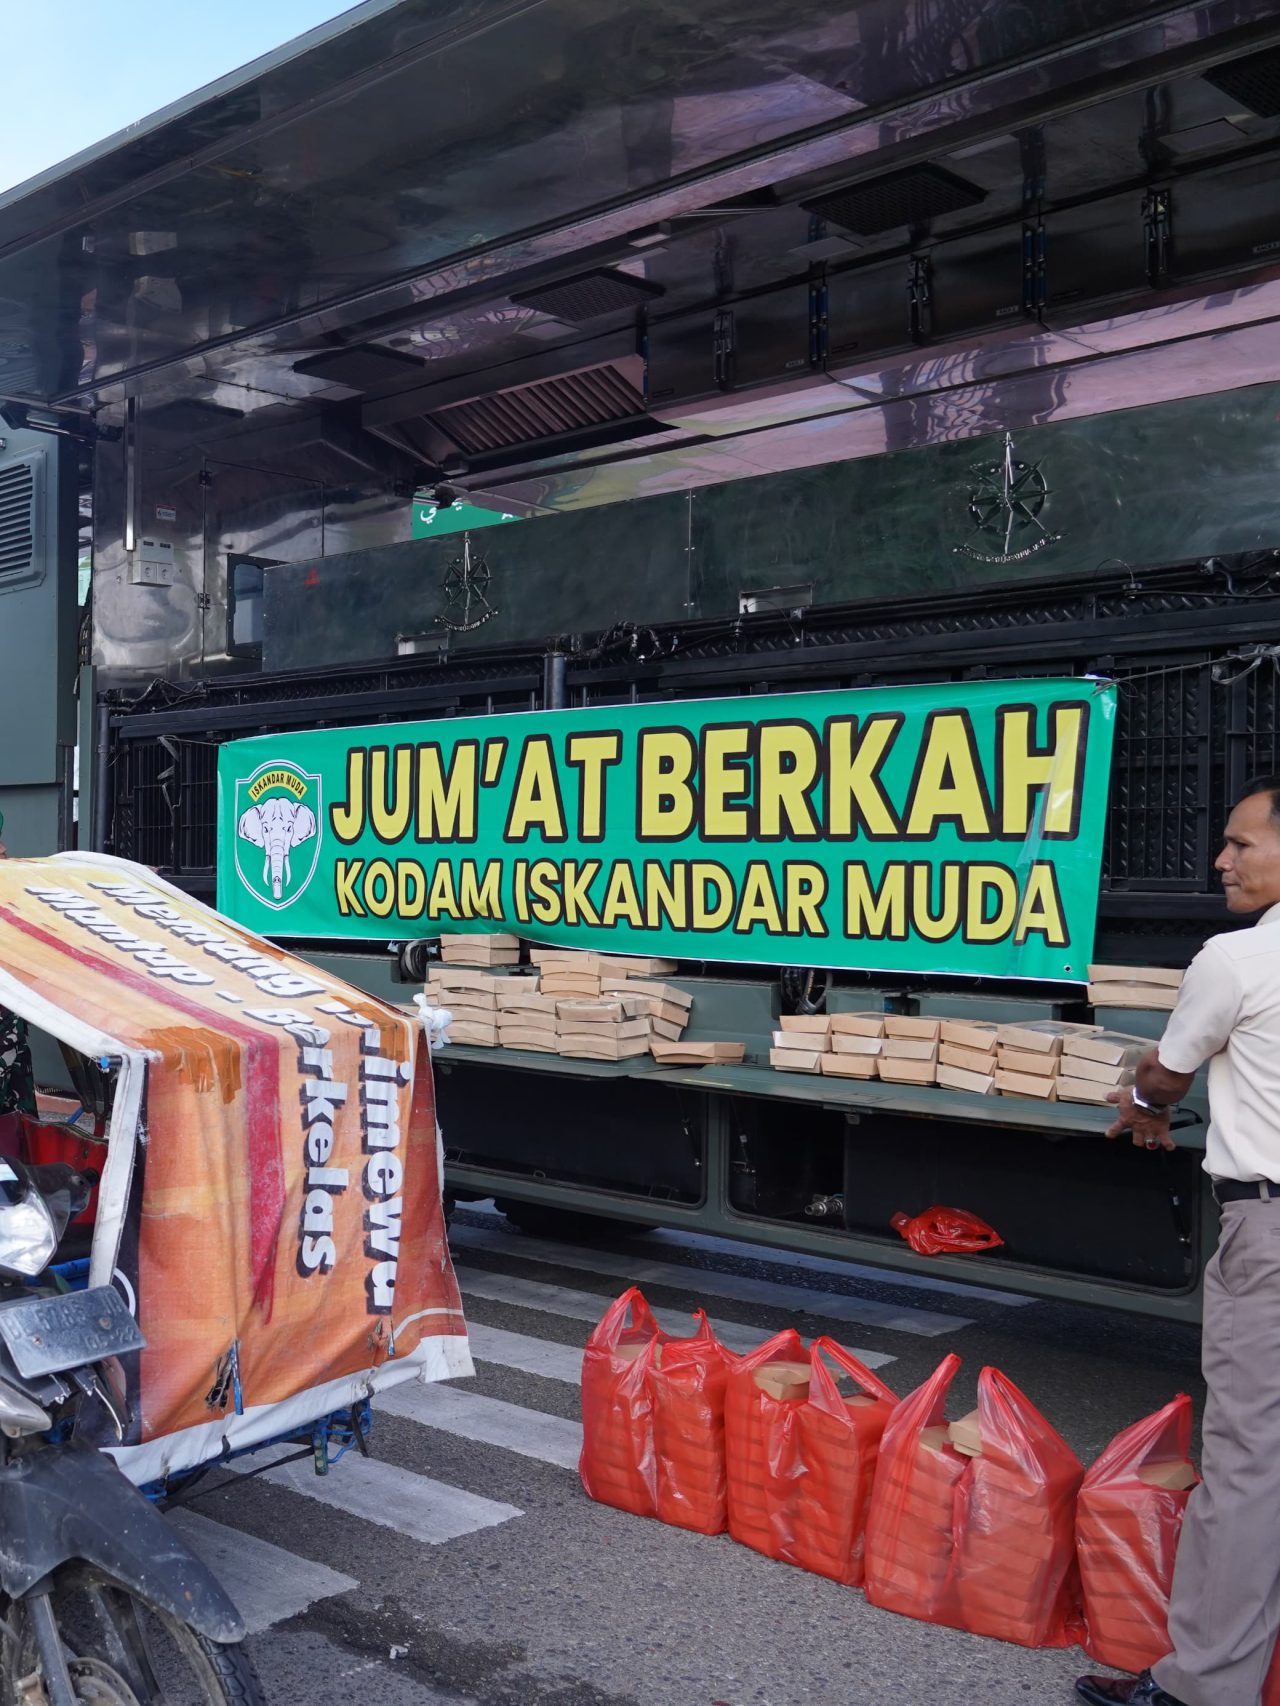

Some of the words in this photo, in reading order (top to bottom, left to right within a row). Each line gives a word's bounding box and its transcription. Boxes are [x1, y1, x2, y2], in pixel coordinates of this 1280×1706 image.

[251, 773, 284, 797] ISKANDAR
[286, 774, 305, 796] MUDA
[328, 728, 624, 844] JUM'AT
[634, 700, 1094, 844] BERKAH
[88, 881, 326, 998] Memang
[333, 857, 505, 922] KODAM
[513, 858, 828, 936] ISKANDAR
[842, 858, 1072, 948] MUDA
[25, 887, 215, 986] Mantap
[243, 1007, 350, 1278] Berkelas
